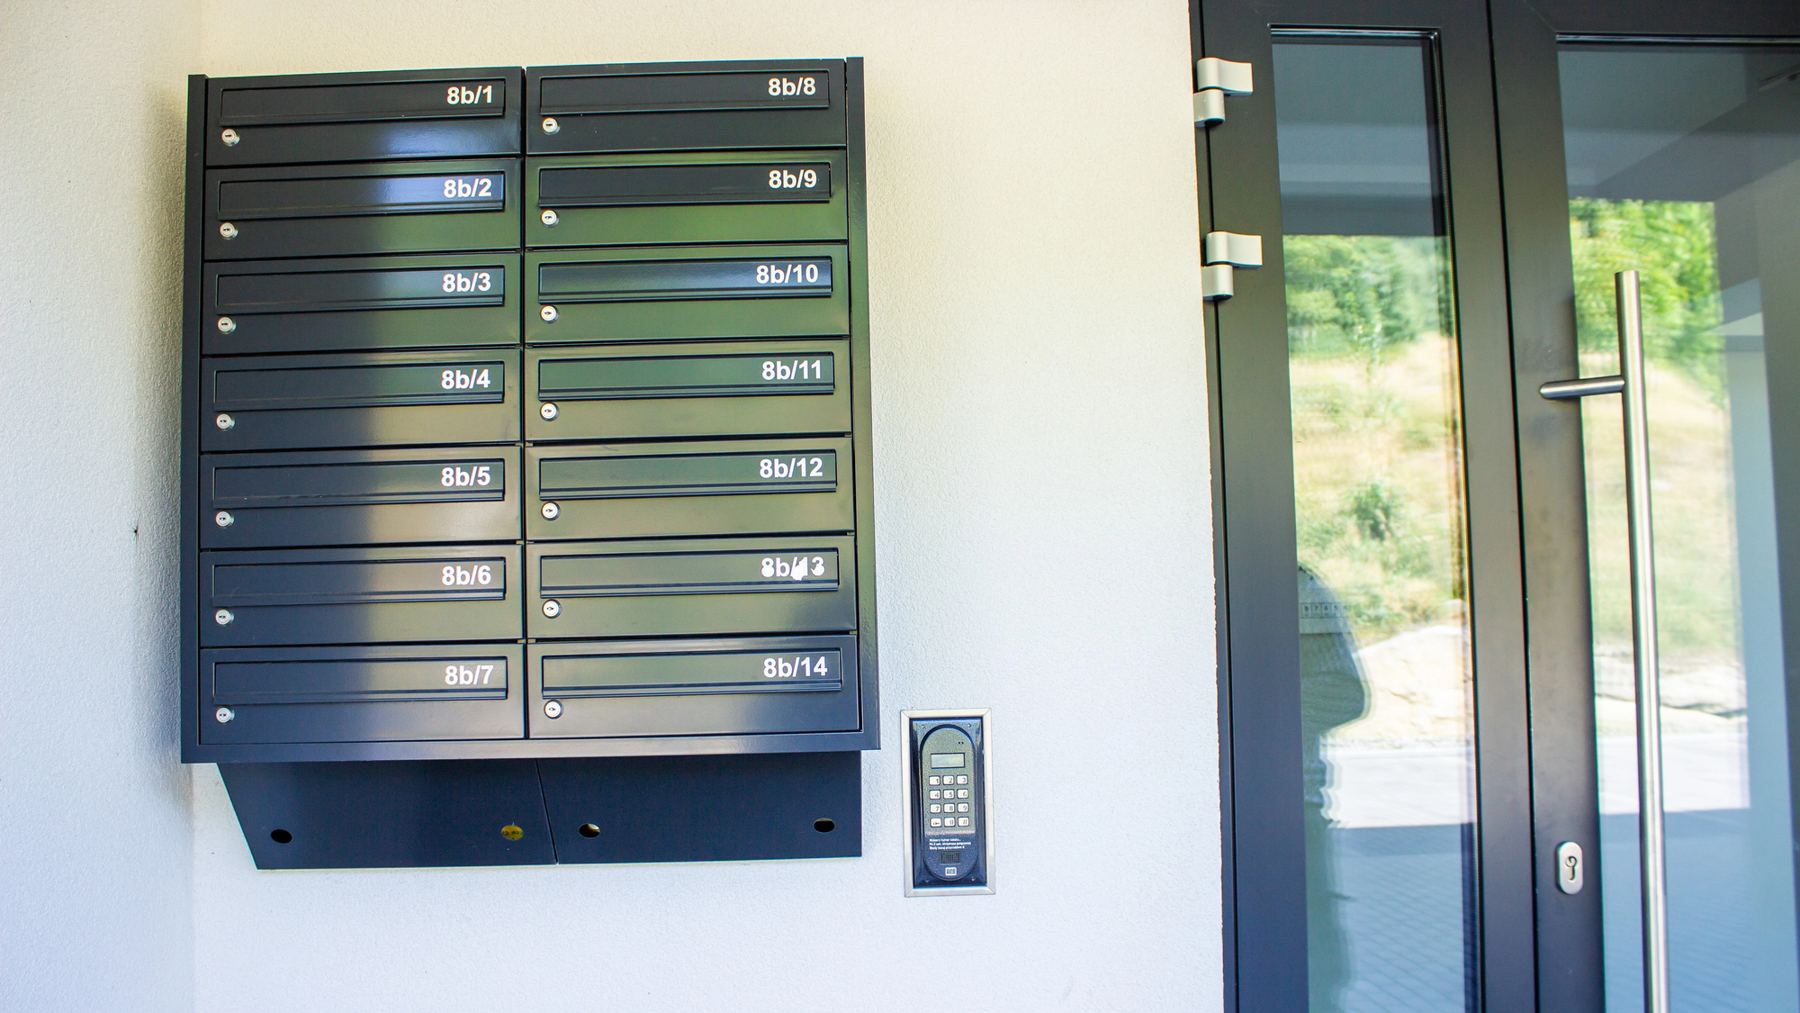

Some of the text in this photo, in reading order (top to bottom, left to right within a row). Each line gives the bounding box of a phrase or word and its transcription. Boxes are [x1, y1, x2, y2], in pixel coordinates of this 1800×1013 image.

[447, 85, 492, 105] 8b/1
[768, 77, 816, 96] 8b/8
[443, 177, 492, 199] 8b/2
[769, 169, 817, 189] 8b/9
[442, 272, 491, 293] 8b/3
[756, 264, 819, 284] 8b/10
[441, 368, 491, 390] 8b/4
[761, 359, 821, 381] 8b/11
[441, 465, 491, 487] 8b/5
[759, 457, 823, 479] 8b/12
[442, 565, 492, 586] 8b/6
[760, 556, 825, 581] 8b/13
[445, 664, 494, 685] 8b/7
[763, 656, 828, 679] 8b/14
